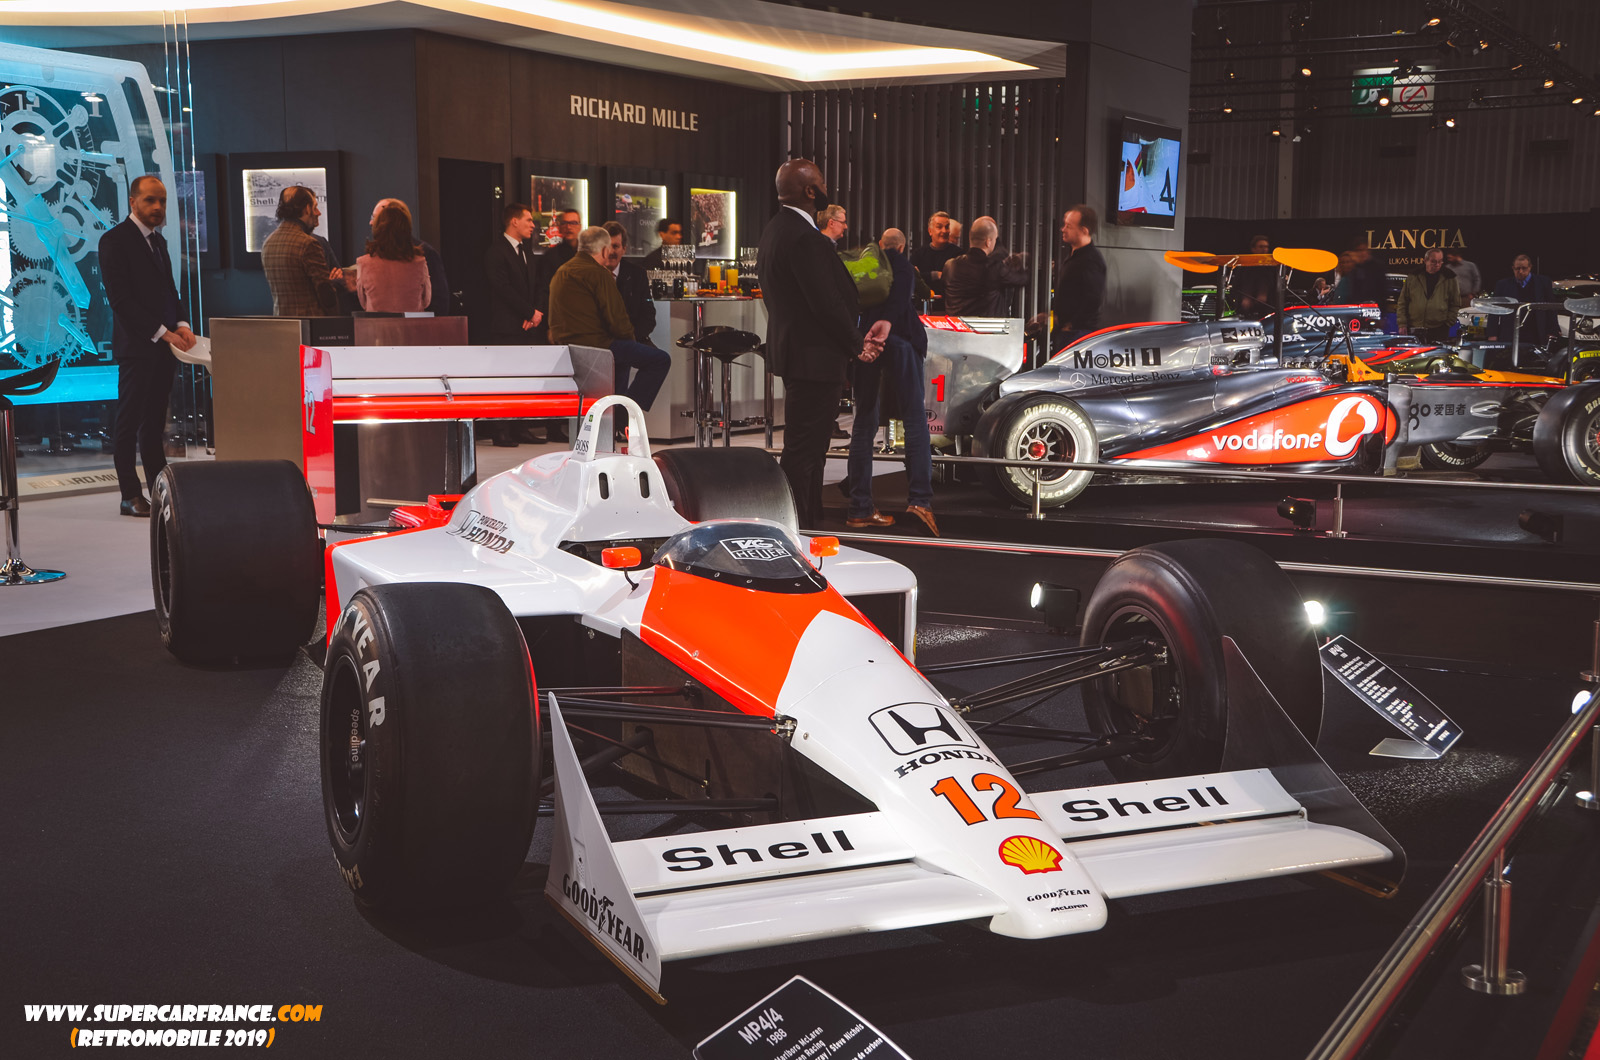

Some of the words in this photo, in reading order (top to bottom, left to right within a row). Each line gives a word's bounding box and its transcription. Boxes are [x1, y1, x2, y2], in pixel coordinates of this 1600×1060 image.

[570, 94, 646, 125] RICHARD
[652, 107, 698, 132] MILLE
[1159, 166, 1175, 212] 4
[250, 198, 274, 206] Shell
[1365, 228, 1468, 250] LANCIA
[1388, 257, 1409, 265] LUKAS
[1239, 327, 1262, 338] xtb
[1073, 348, 1136, 369] Mobil
[931, 374, 946, 402] 1
[1091, 371, 1181, 386] Mercedes-Benz
[1285, 376, 1323, 384] vodafone
[1024, 403, 1087, 430] BRIDGESTONE
[1434, 403, 1467, 416] 爱国者
[1212, 429, 1322, 451] vodafone
[477, 515, 504, 530] POWERED
[461, 525, 515, 554] HONDA
[731, 538, 774, 549] TAG
[733, 549, 788, 560] HEUER
[350, 708, 361, 763] speedline
[894, 750, 1003, 779] HONDA
[930, 773, 1043, 826] 12
[1062, 786, 1229, 822] Shell
[662, 829, 855, 872] Shell
[1027, 888, 1091, 902] GOODYEAR
[563, 873, 644, 963] GOODYEAR
[1050, 903, 1088, 912] McLaren
[737, 1007, 784, 1045] MP4/4
[798, 1026, 824, 1047] McLaren
[766, 1028, 788, 1046] 1988
[829, 1037, 847, 1053] Steve
[843, 1023, 865, 1041] Nichols
[863, 1037, 884, 1055] carbone
[804, 1039, 827, 1058] Racing
